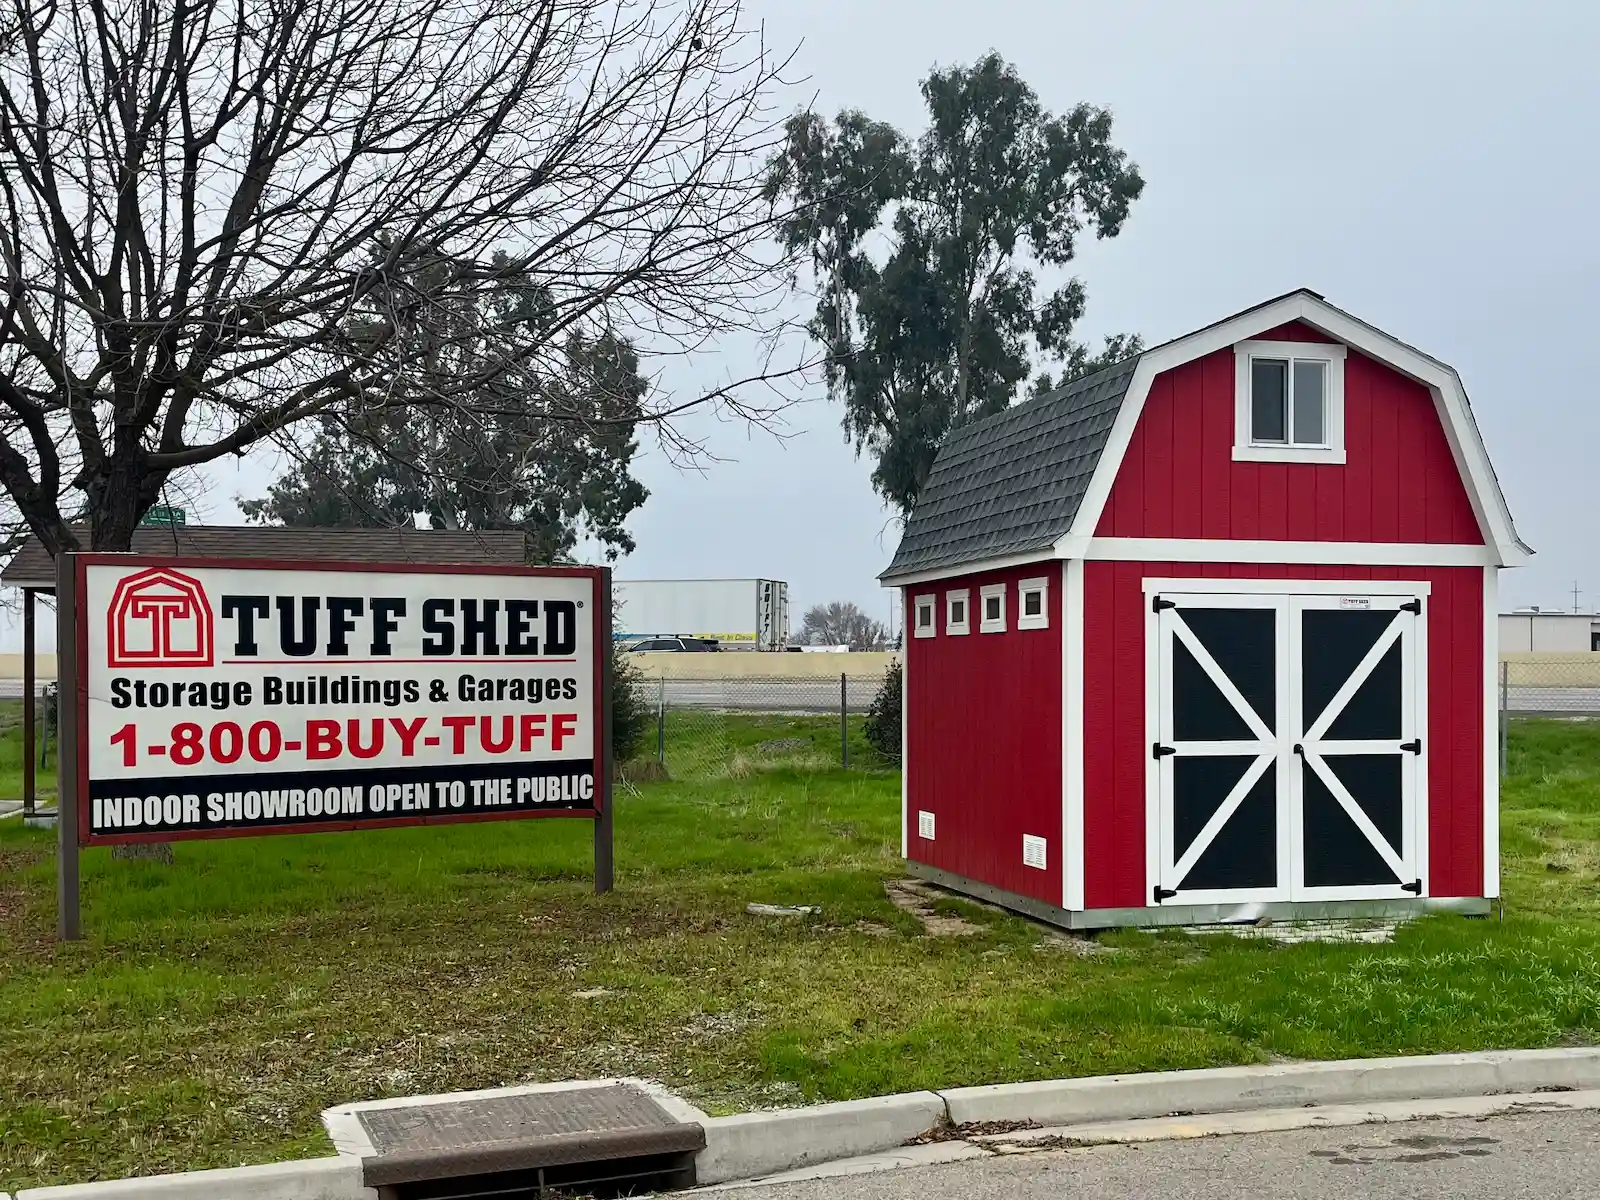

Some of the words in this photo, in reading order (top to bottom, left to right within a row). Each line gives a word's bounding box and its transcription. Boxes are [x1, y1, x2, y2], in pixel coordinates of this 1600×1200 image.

[222, 595, 407, 656] TUFF
[422, 599, 576, 656] SHED
[110, 677, 252, 710] Storage
[264, 675, 420, 707] Buildings
[428, 678, 449, 703] &
[457, 674, 577, 704] Garages
[110, 713, 578, 767] 1-800-BUY-TUFF
[93, 795, 200, 829] INDOOR
[206, 786, 363, 822] SHOWROOM
[369, 783, 430, 812] OPEN
[435, 781, 465, 808] TO
[470, 778, 512, 806] THE
[517, 774, 594, 804] PUBLIC
